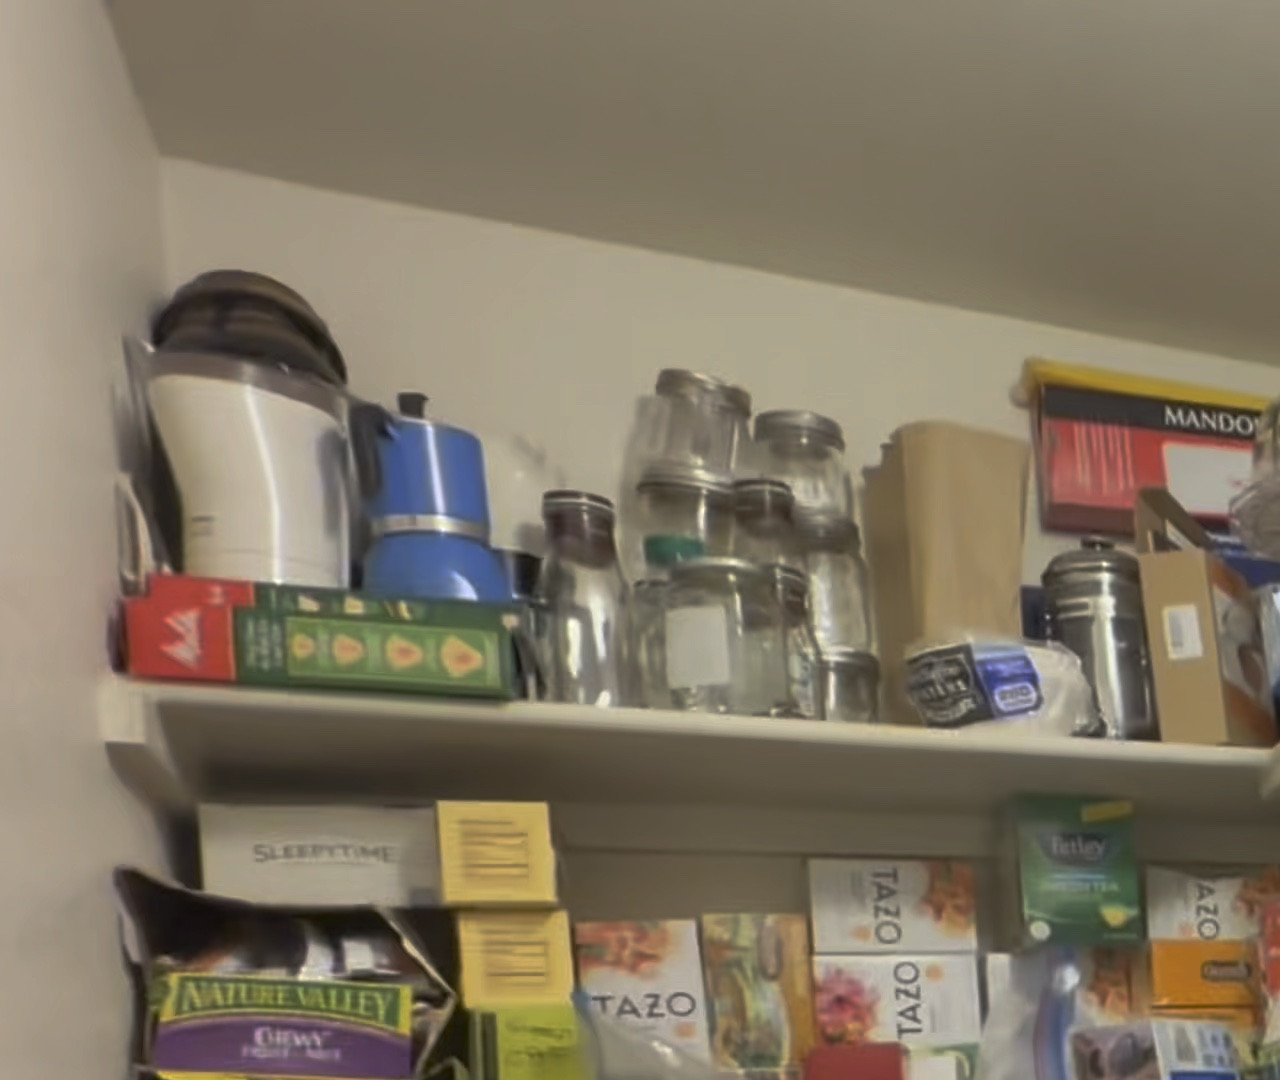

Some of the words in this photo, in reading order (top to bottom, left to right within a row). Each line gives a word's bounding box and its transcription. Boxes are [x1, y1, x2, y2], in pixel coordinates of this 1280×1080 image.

[1164, 405, 1260, 436] MANDO
[253, 843, 399, 864] SLEEPYTIME
[871, 867, 903, 945] TAZO
[1195, 879, 1221, 941] AZO
[182, 980, 291, 1013] NATURE
[297, 984, 396, 1026] VALLEY
[591, 990, 697, 1020] TAZO
[893, 960, 924, 1039] TAZO
